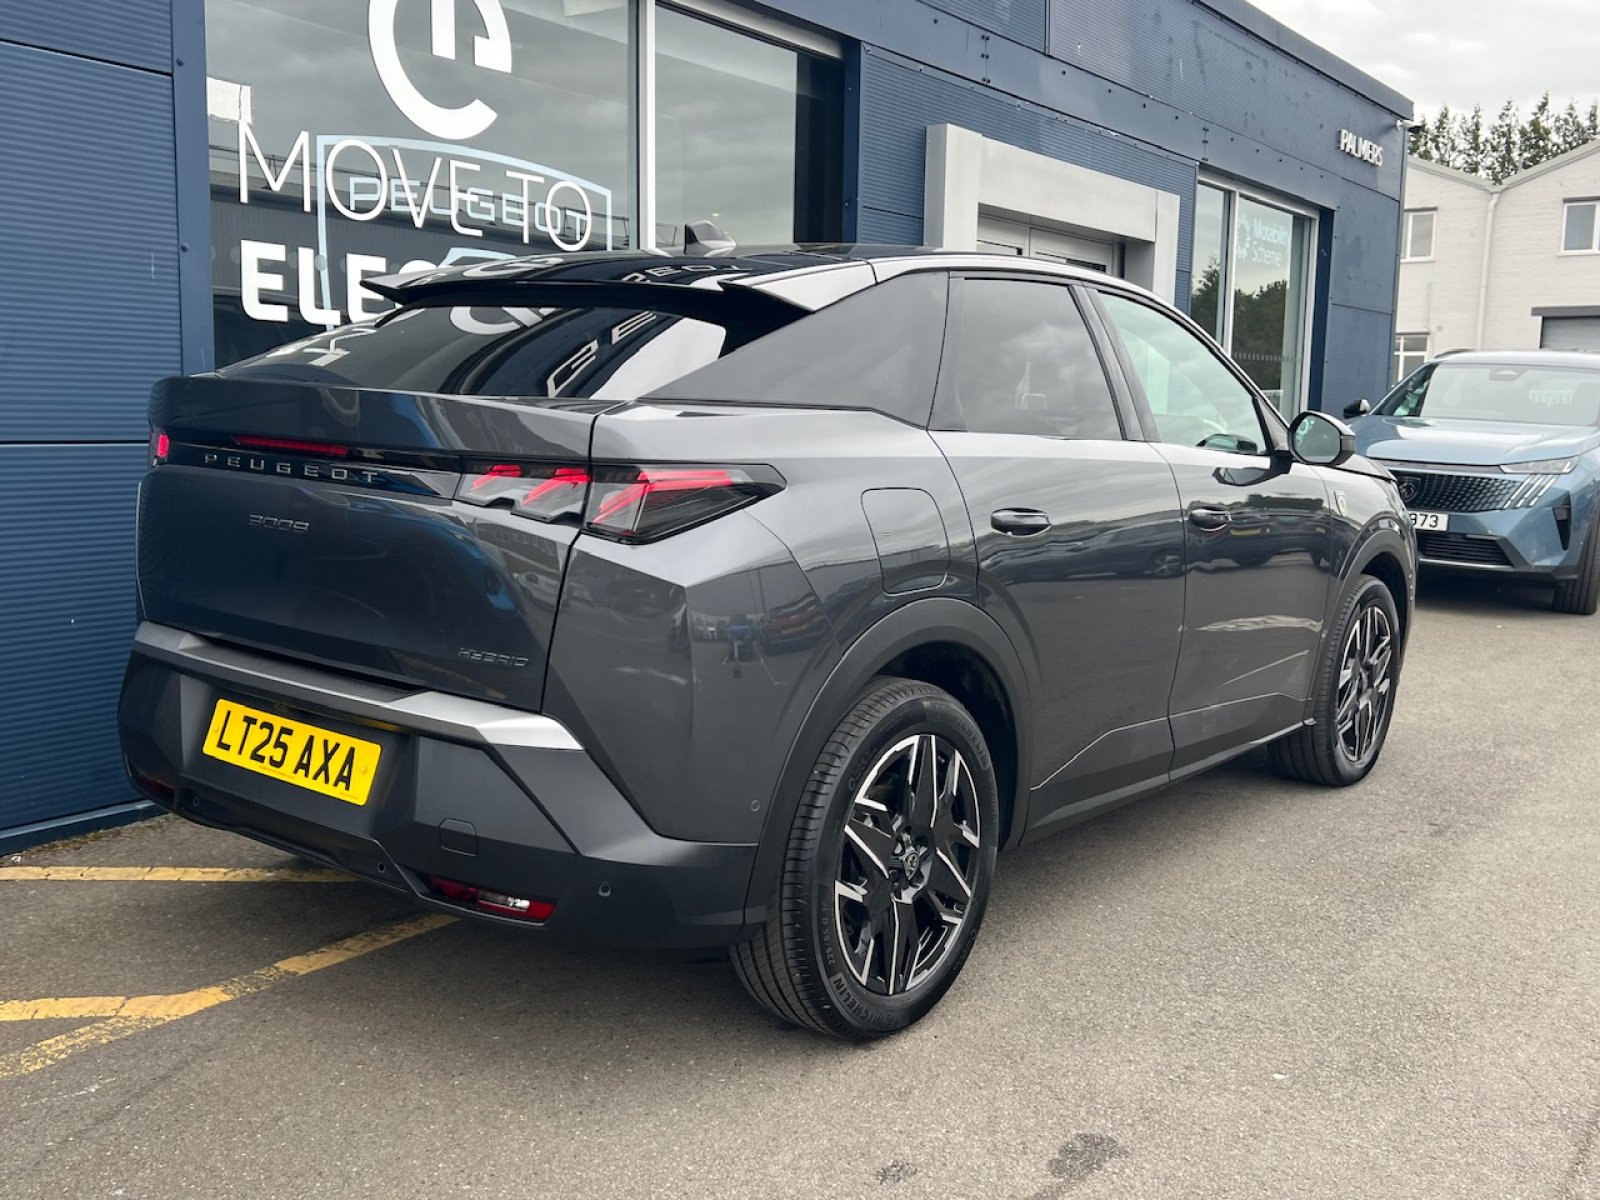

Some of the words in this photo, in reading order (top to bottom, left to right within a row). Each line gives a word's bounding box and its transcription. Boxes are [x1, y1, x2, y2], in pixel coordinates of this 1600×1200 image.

[1341, 129, 1383, 167] PALMERS
[239, 121, 483, 237] MOVE
[505, 170, 592, 252] TO
[349, 177, 588, 241] PEUGEOT
[1253, 241, 1281, 267] Scheme
[204, 453, 378, 483] PEUGEOT
[249, 514, 310, 533] 3008
[458, 647, 529, 667] HYBRID
[216, 709, 294, 768] LT25
[293, 734, 356, 791] AXA
[833, 976, 883, 1025] MICHELIN
